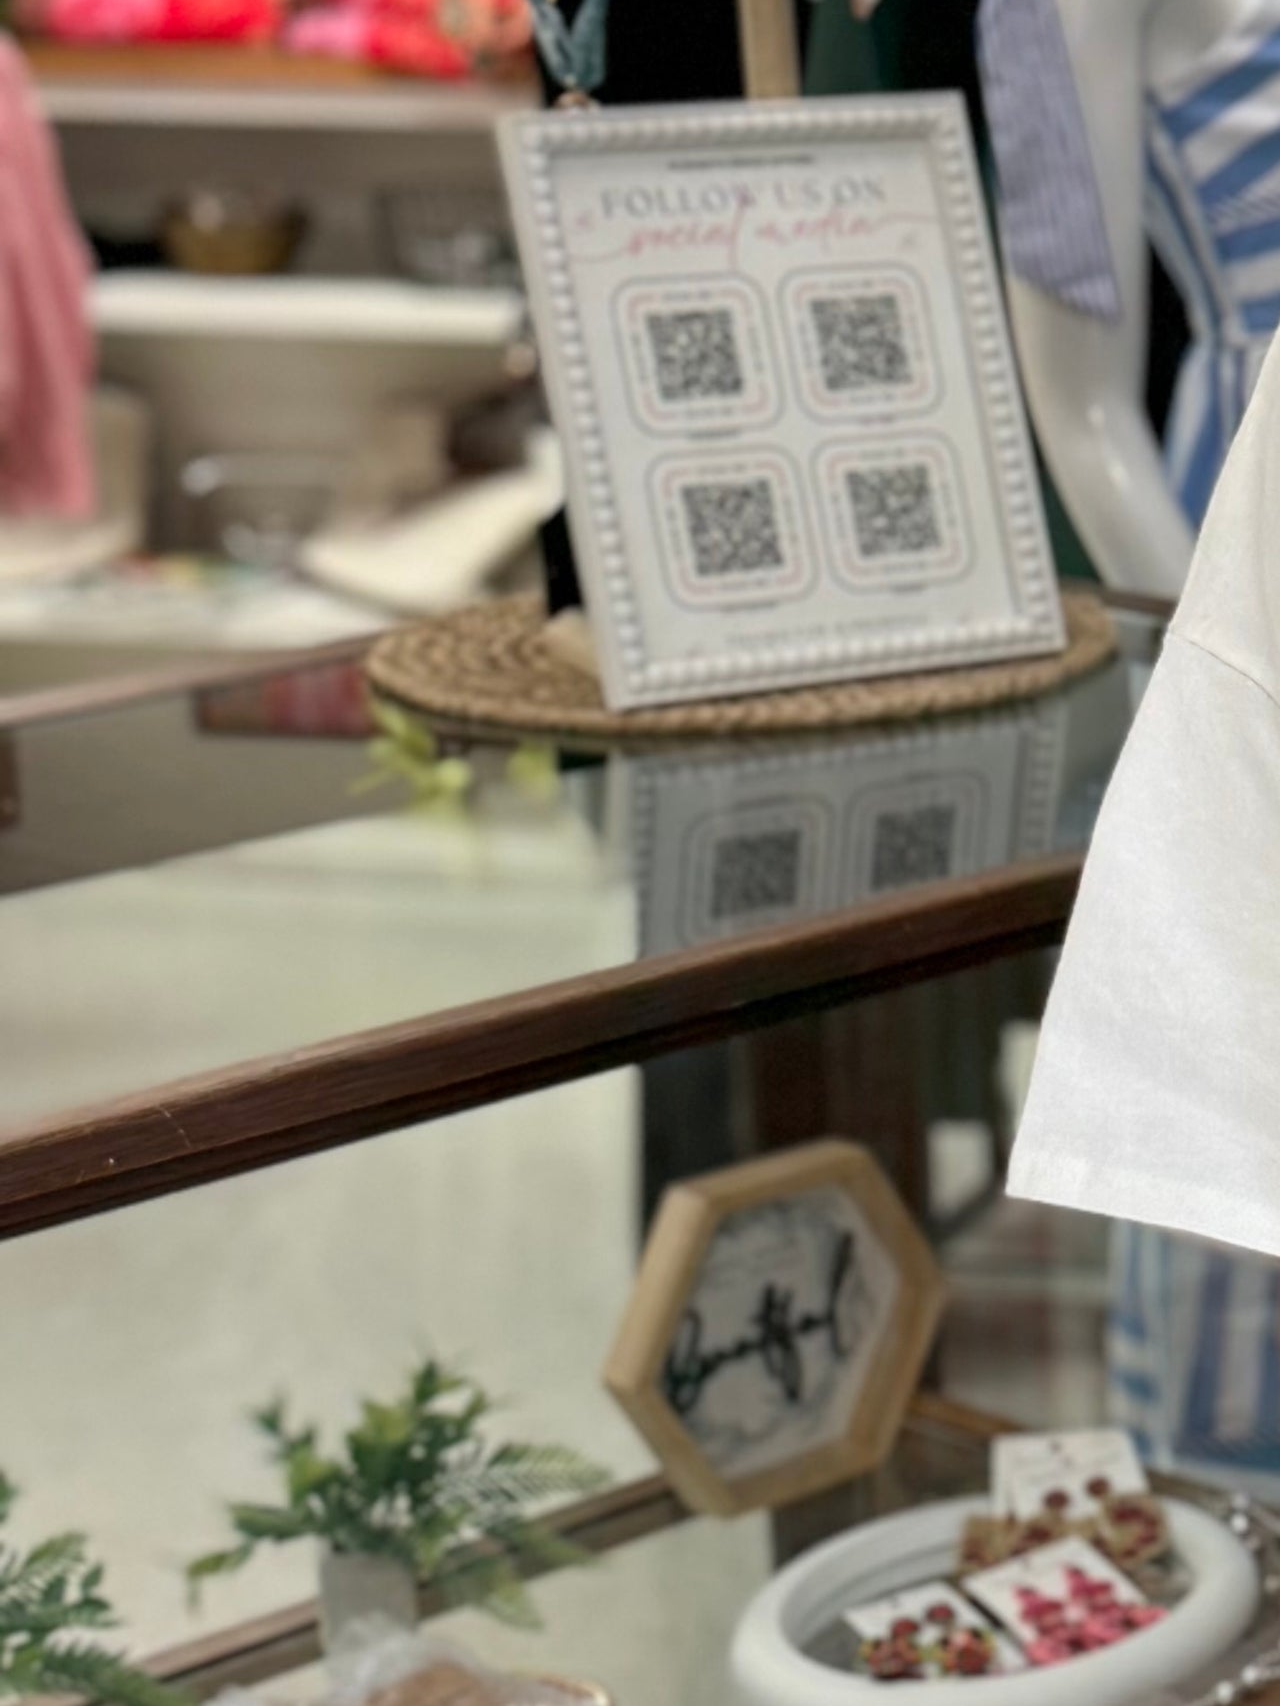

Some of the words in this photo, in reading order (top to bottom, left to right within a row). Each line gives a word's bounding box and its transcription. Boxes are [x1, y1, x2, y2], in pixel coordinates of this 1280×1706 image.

[599, 180, 757, 220] FOLLOW
[774, 176, 822, 208] US
[831, 173, 887, 206] ON
